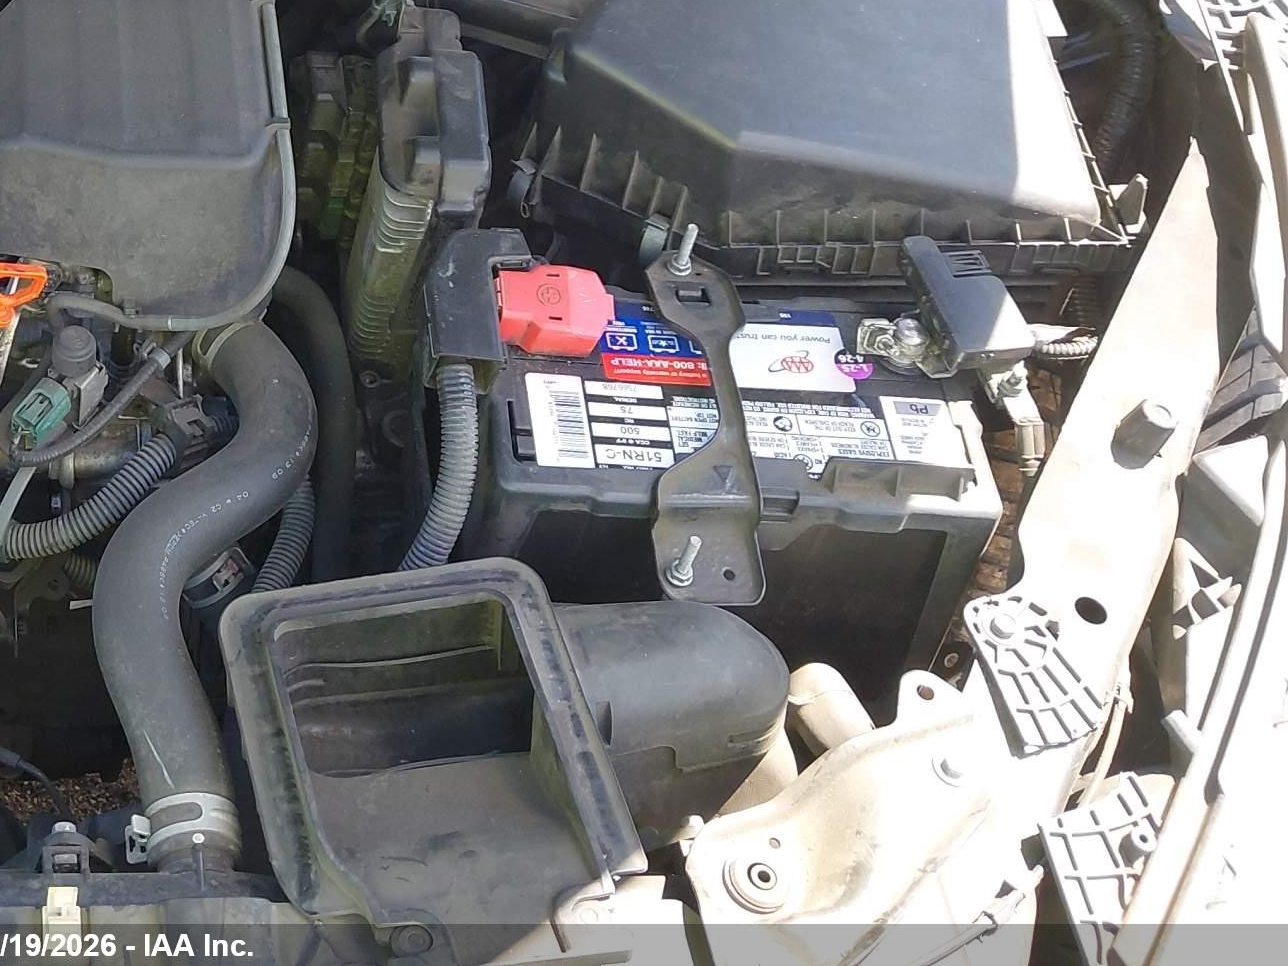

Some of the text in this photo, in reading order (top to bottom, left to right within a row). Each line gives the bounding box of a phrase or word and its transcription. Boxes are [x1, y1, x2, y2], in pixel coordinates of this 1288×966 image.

[761, 333, 777, 341] can
[780, 333, 798, 342] you
[801, 335, 831, 344] Power
[838, 354, 864, 363] 4-26
[610, 358, 695, 370] 800-AAA-HELP
[909, 403, 929, 415] Pb
[620, 425, 640, 435] 500
[605, 448, 662, 463] 51RN-C
